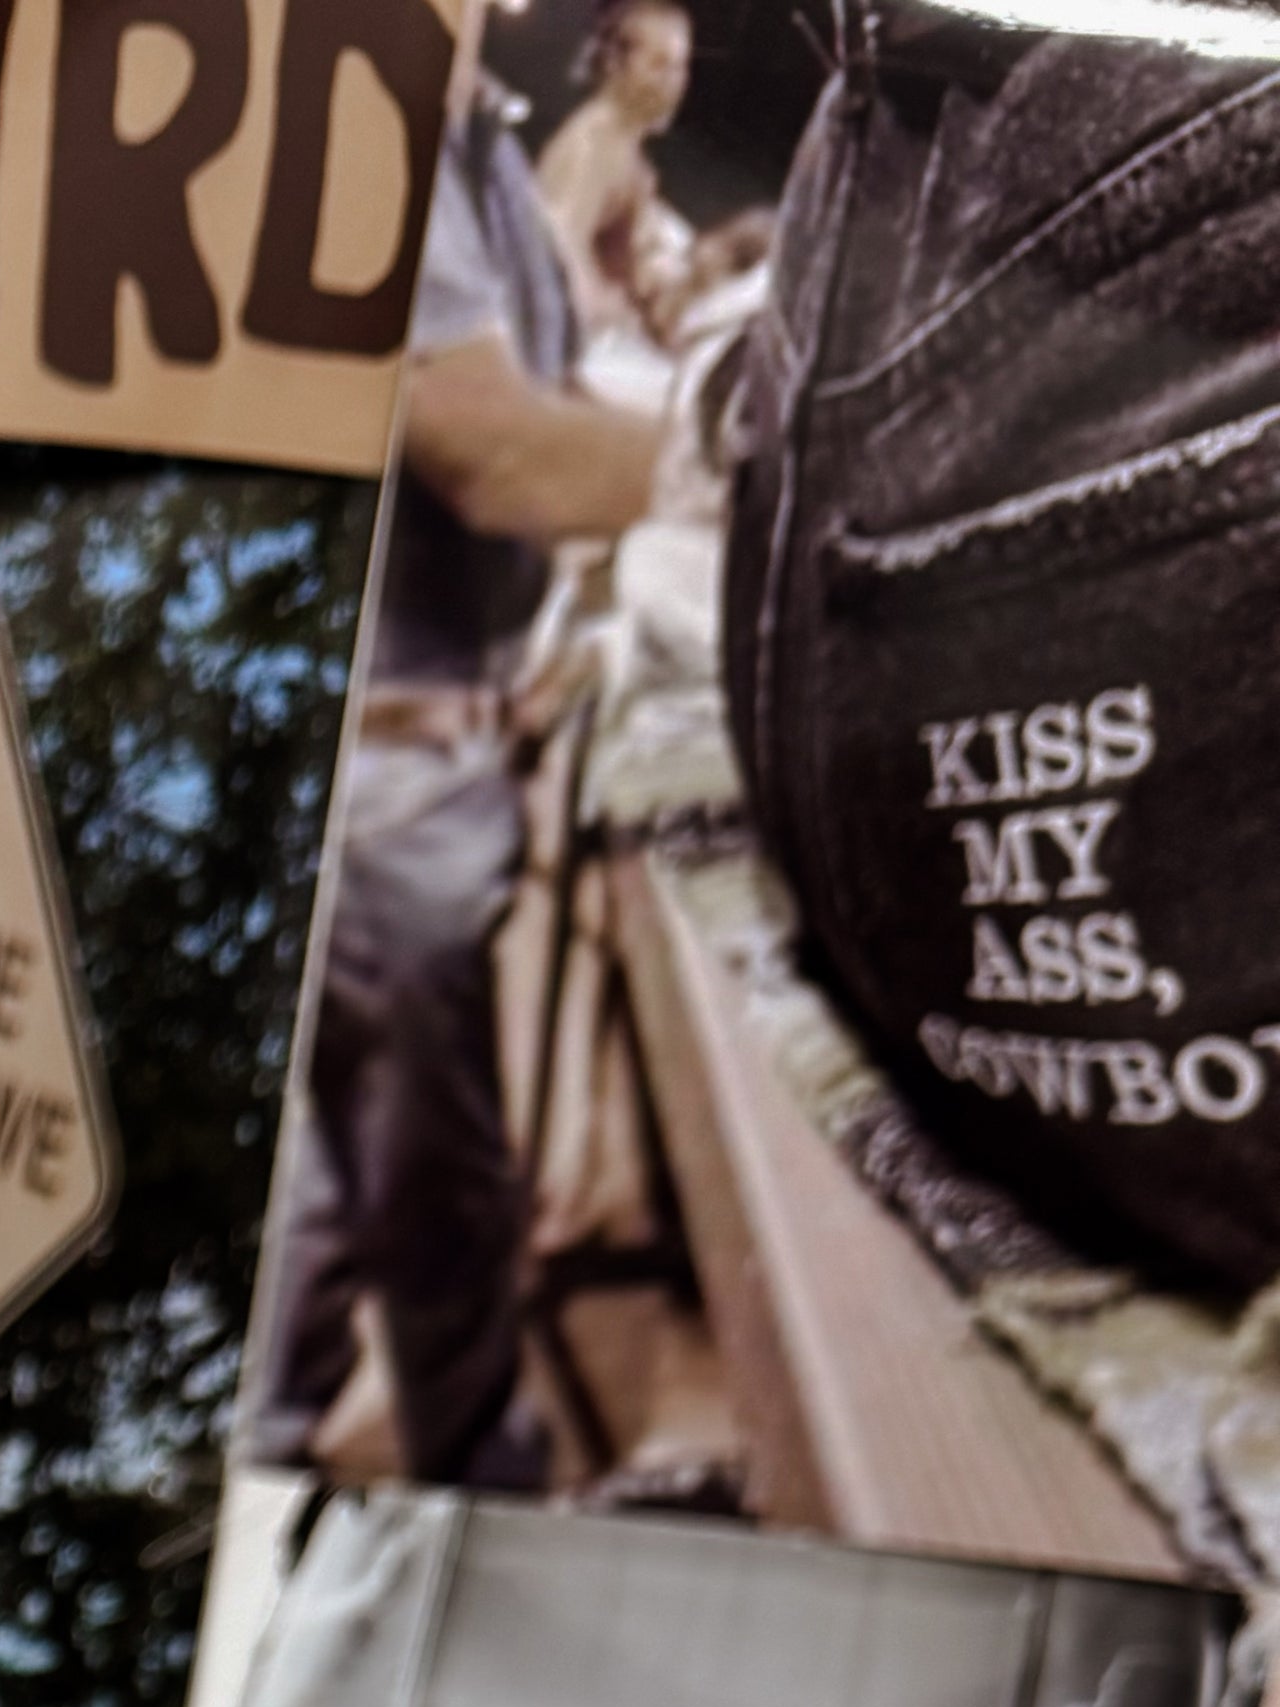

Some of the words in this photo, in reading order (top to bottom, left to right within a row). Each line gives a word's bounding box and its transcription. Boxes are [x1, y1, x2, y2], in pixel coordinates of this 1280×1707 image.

[918, 683, 1156, 808] KISS
[952, 799, 1121, 906] MY
[965, 910, 1184, 1016] ASS,
[917, 1010, 1280, 1126] COWBO
